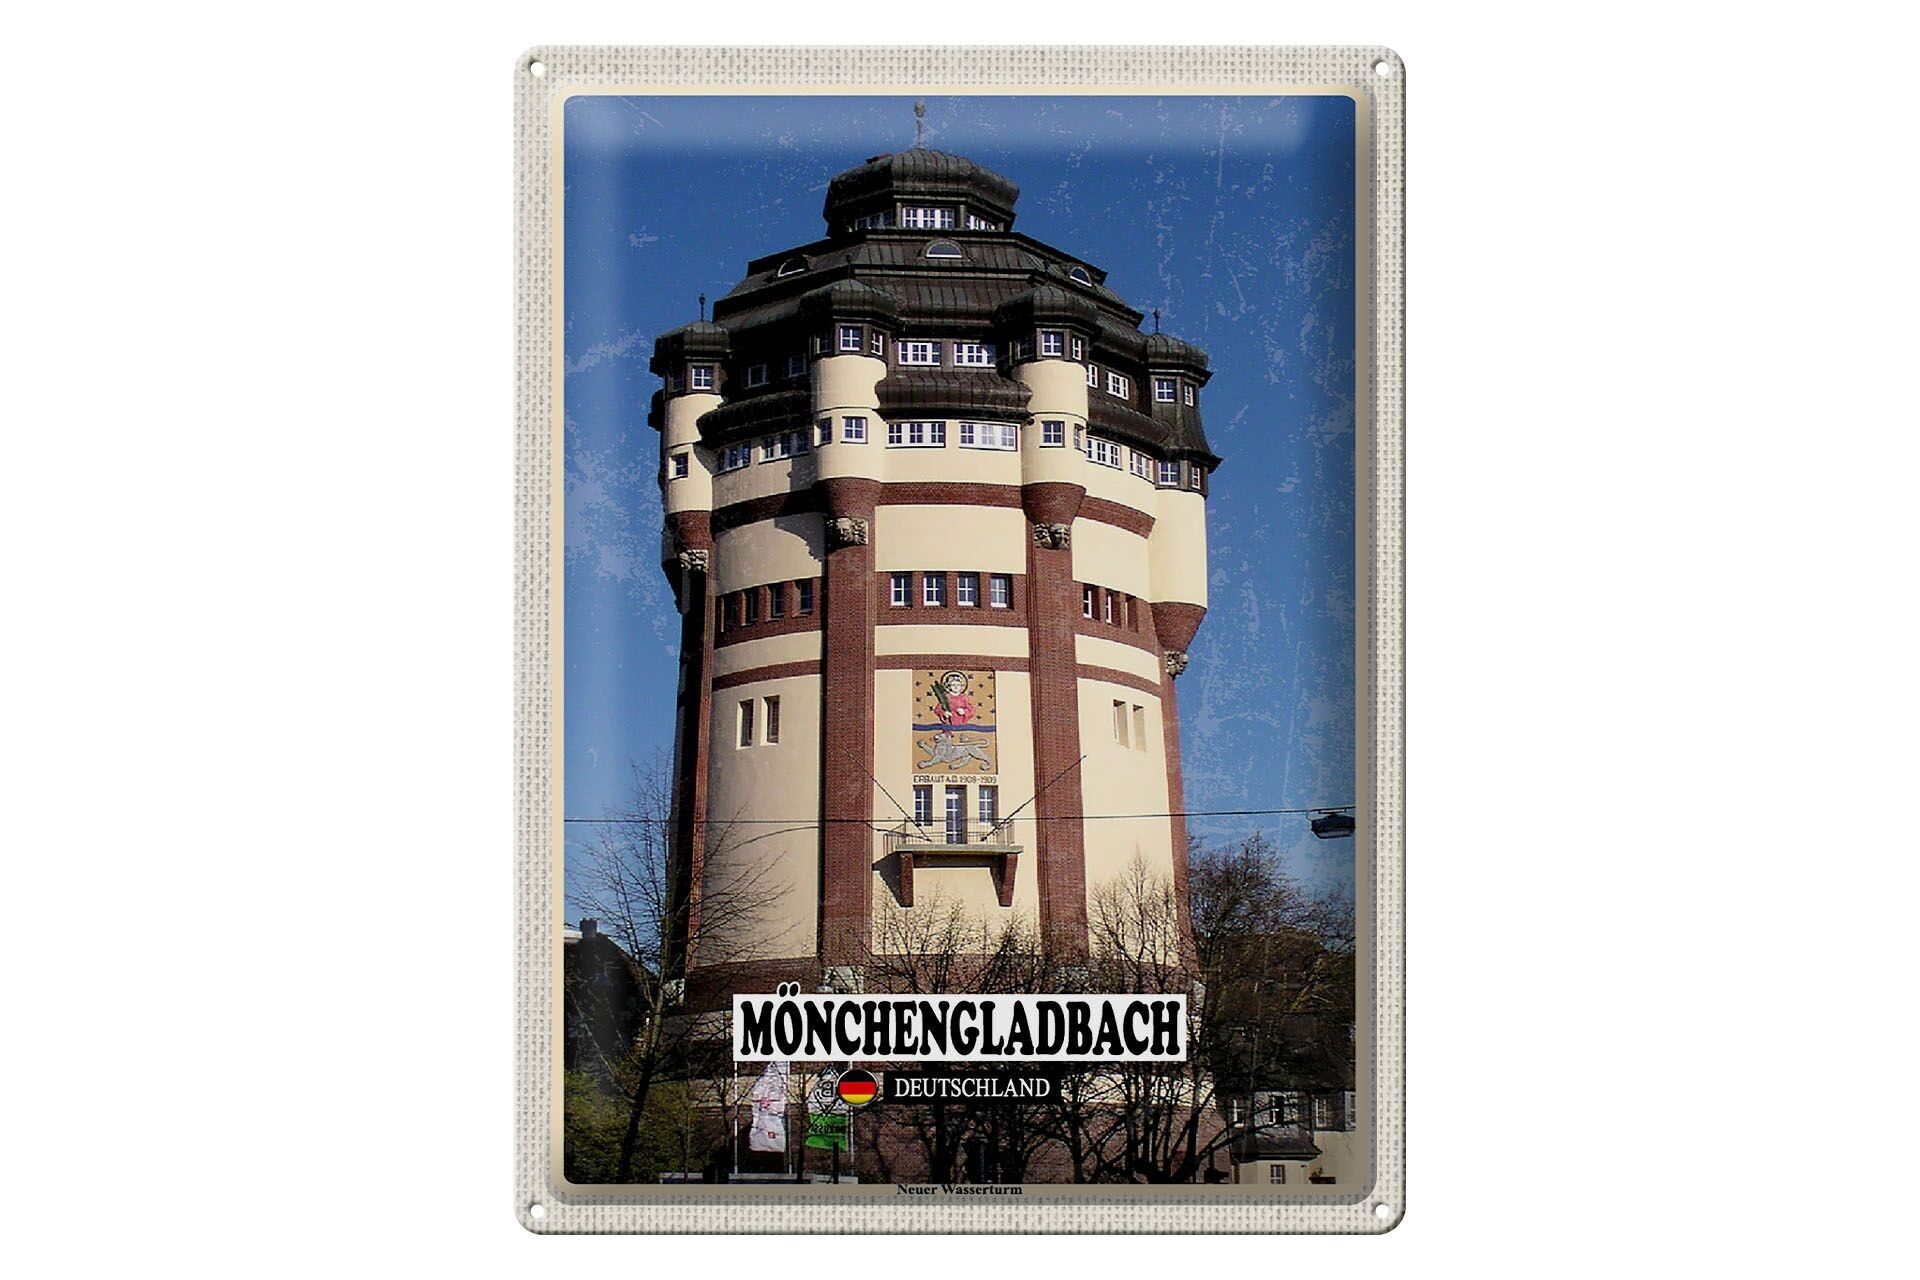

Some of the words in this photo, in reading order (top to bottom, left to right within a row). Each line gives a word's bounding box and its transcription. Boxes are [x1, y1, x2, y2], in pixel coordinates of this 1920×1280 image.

[740, 983, 1181, 1056] MÖNCHENGLADBACH
[894, 1077, 1051, 1098] DEUTSCHLAND
[896, 1184, 938, 1195] Neuer
[941, 1184, 1023, 1195] Wasserturm
